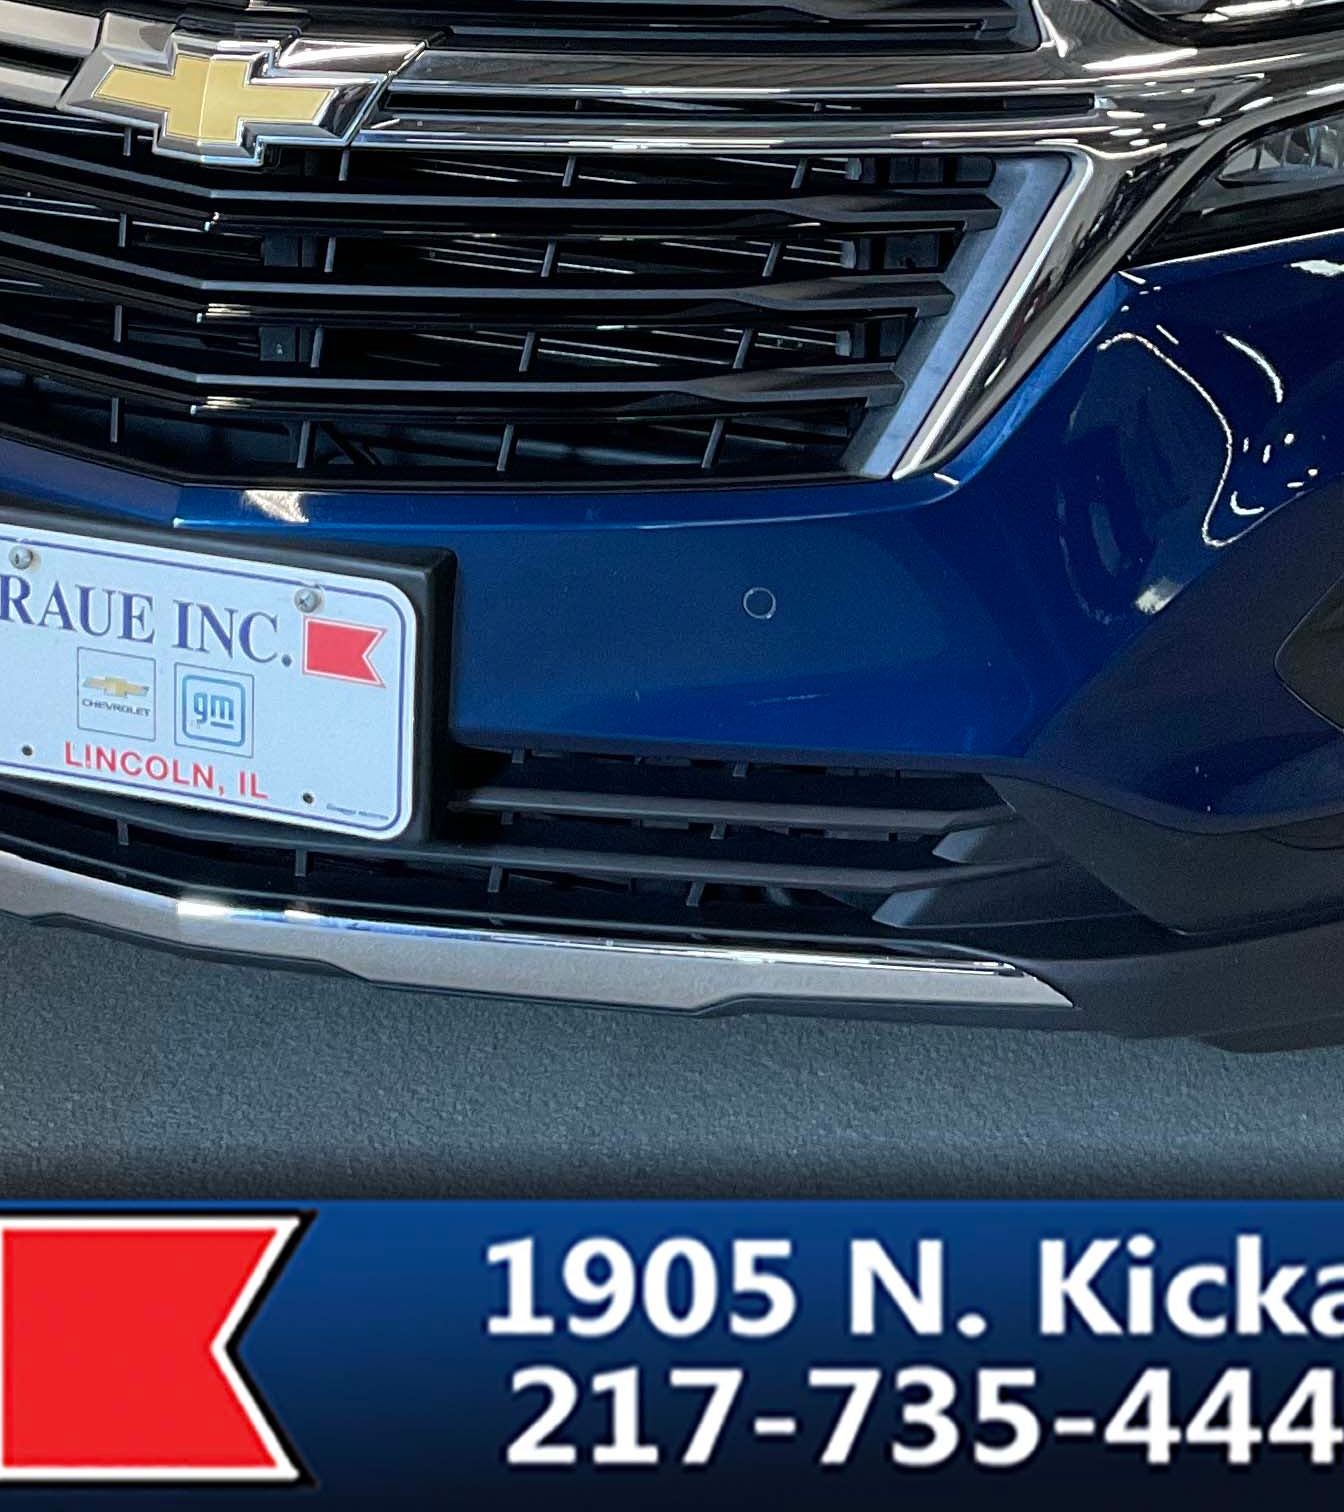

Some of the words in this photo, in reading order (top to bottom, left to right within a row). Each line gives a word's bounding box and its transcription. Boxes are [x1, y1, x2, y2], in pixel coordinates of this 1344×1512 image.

[171, 598, 293, 668] INC.
[81, 697, 151, 718] CHEVROLET
[192, 692, 235, 730] gm
[64, 740, 225, 797] LINCOLN,
[239, 770, 269, 800] IL
